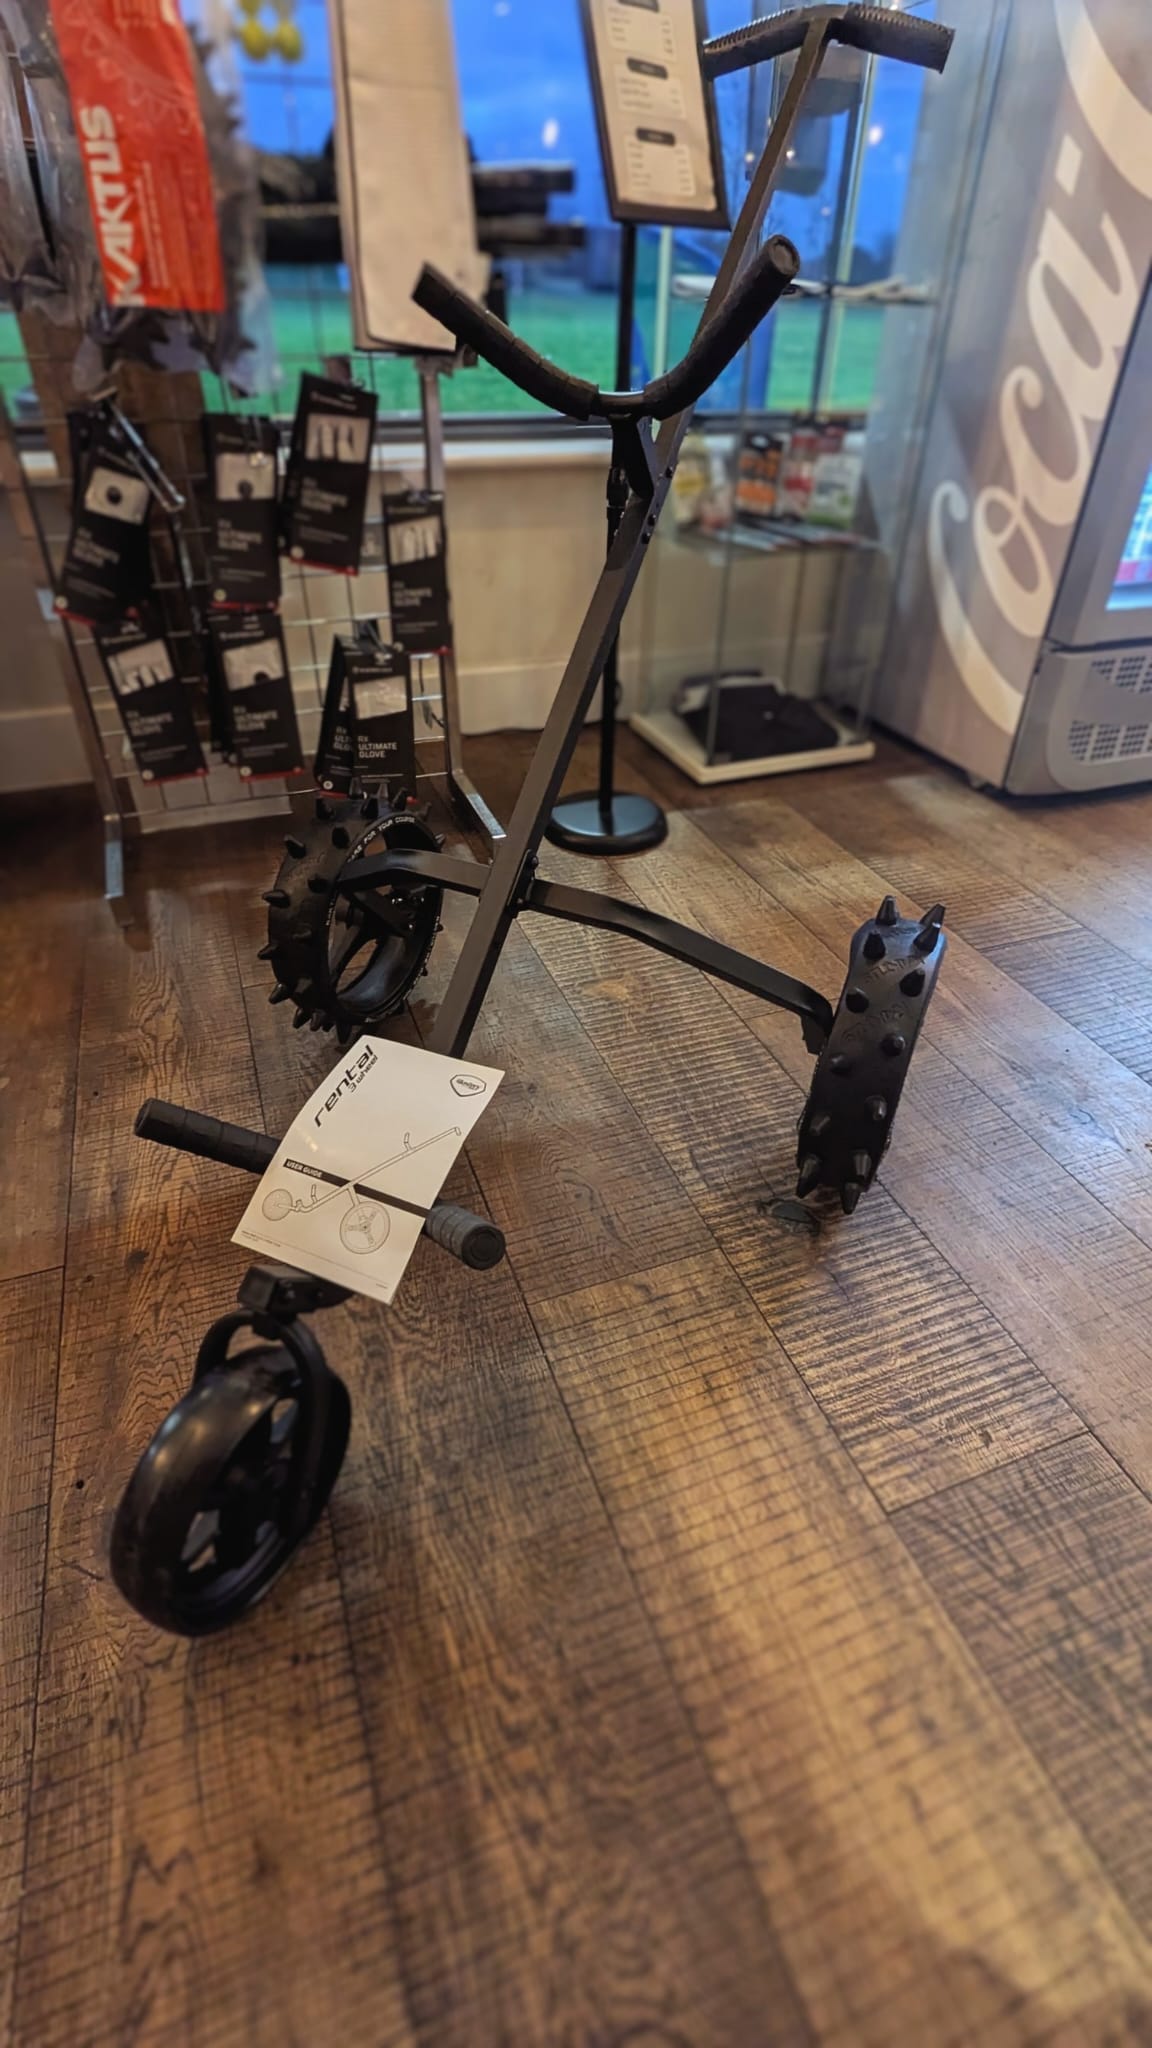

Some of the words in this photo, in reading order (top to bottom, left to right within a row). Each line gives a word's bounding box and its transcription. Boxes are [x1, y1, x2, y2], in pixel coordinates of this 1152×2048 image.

[79, 105, 145, 309] KAKTUS
[358, 742, 397, 751] ULTIMATE
[359, 750, 386, 759] GLOVE
[364, 830, 376, 844] FOR
[378, 819, 393, 831] YOUR
[314, 1044, 373, 1128] rental
[347, 1081, 357, 1093] 3
[356, 1054, 378, 1084] wheel
[286, 1160, 304, 1171] USER
[302, 1166, 323, 1178] GUIDE
